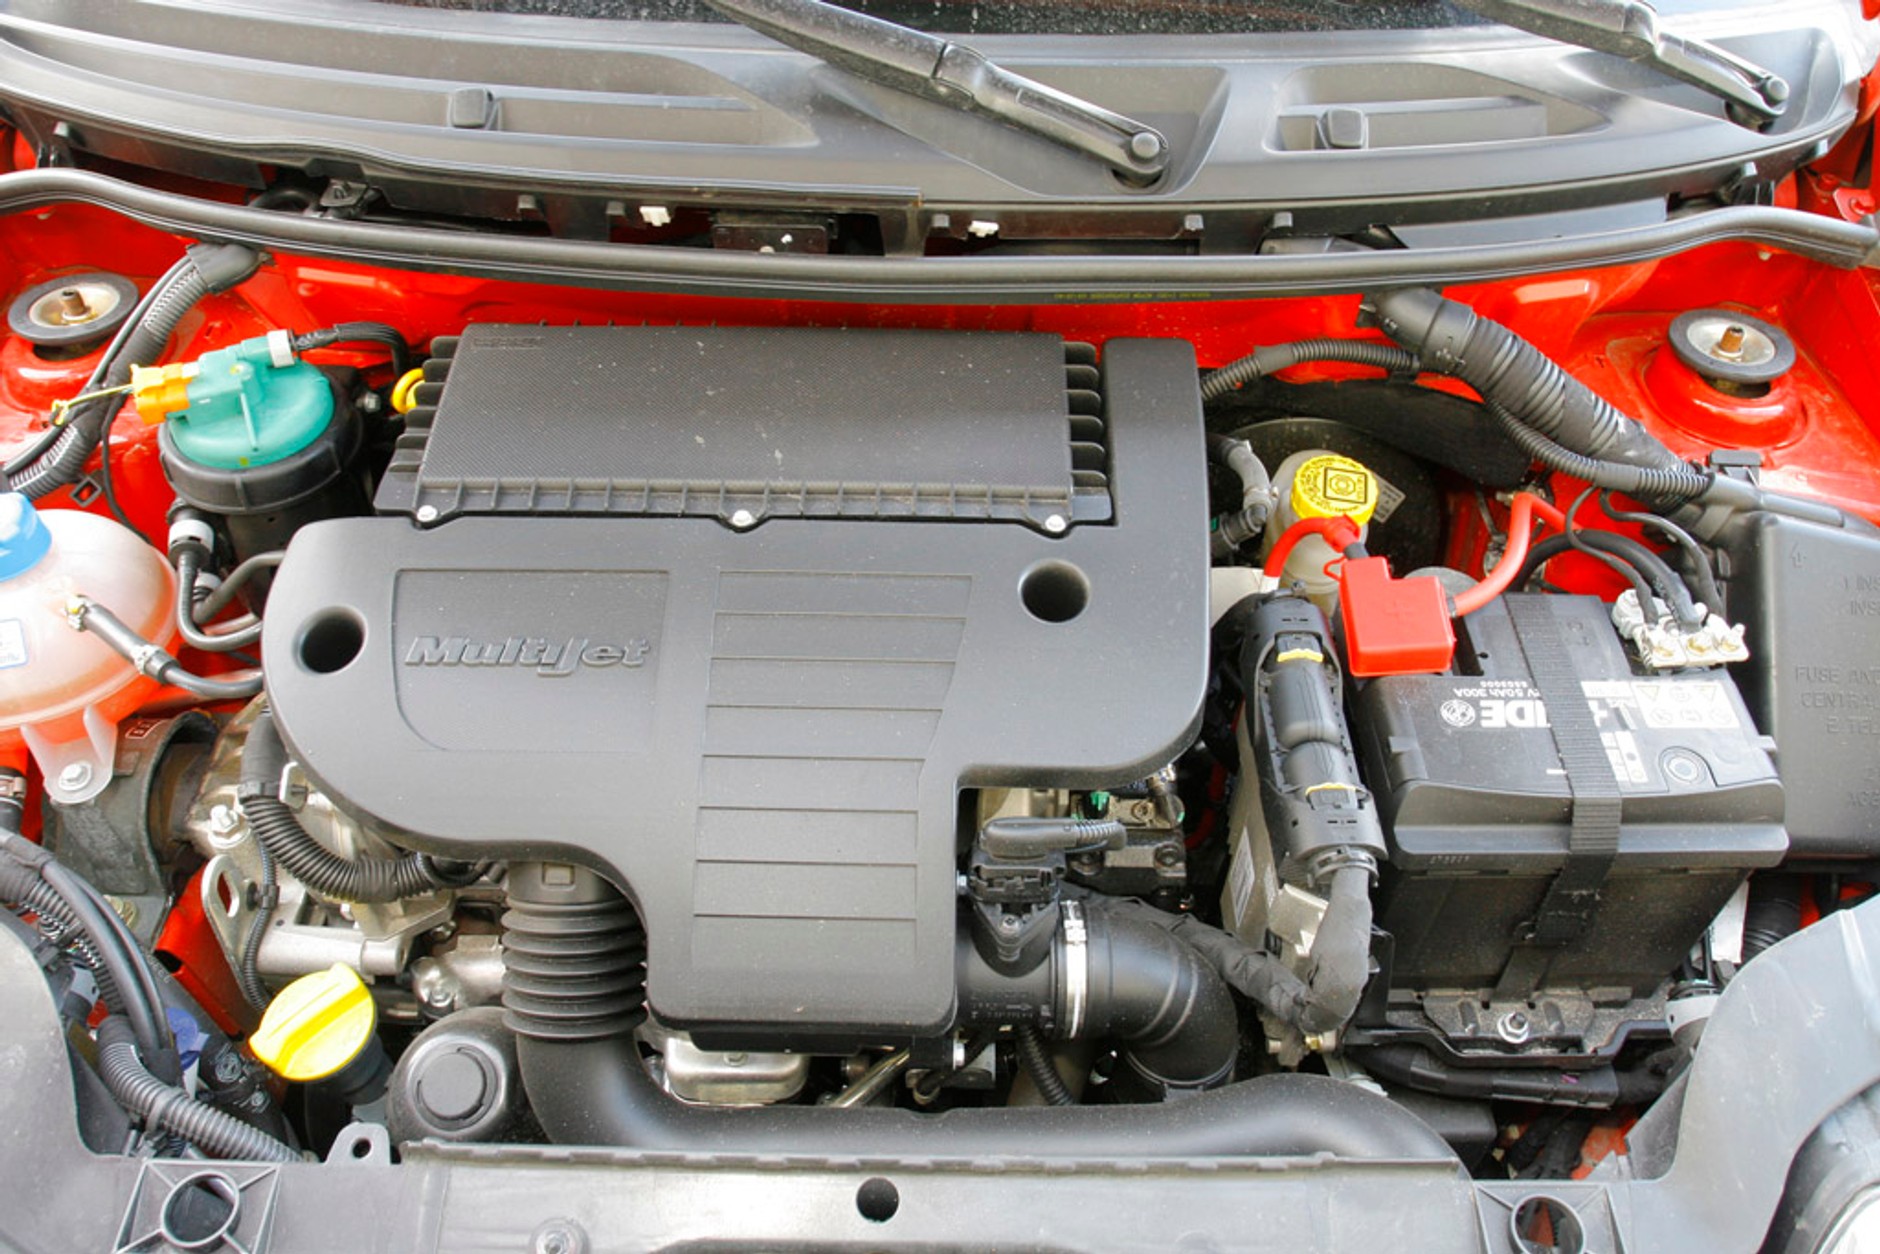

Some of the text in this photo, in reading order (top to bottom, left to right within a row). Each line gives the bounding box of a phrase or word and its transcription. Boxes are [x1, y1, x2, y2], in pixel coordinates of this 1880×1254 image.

[404, 636, 650, 677] MultiJet
[1796, 666, 1840, 684] FUSE
[1453, 688, 1489, 697] 300A
[1480, 700, 1551, 728] IDE
